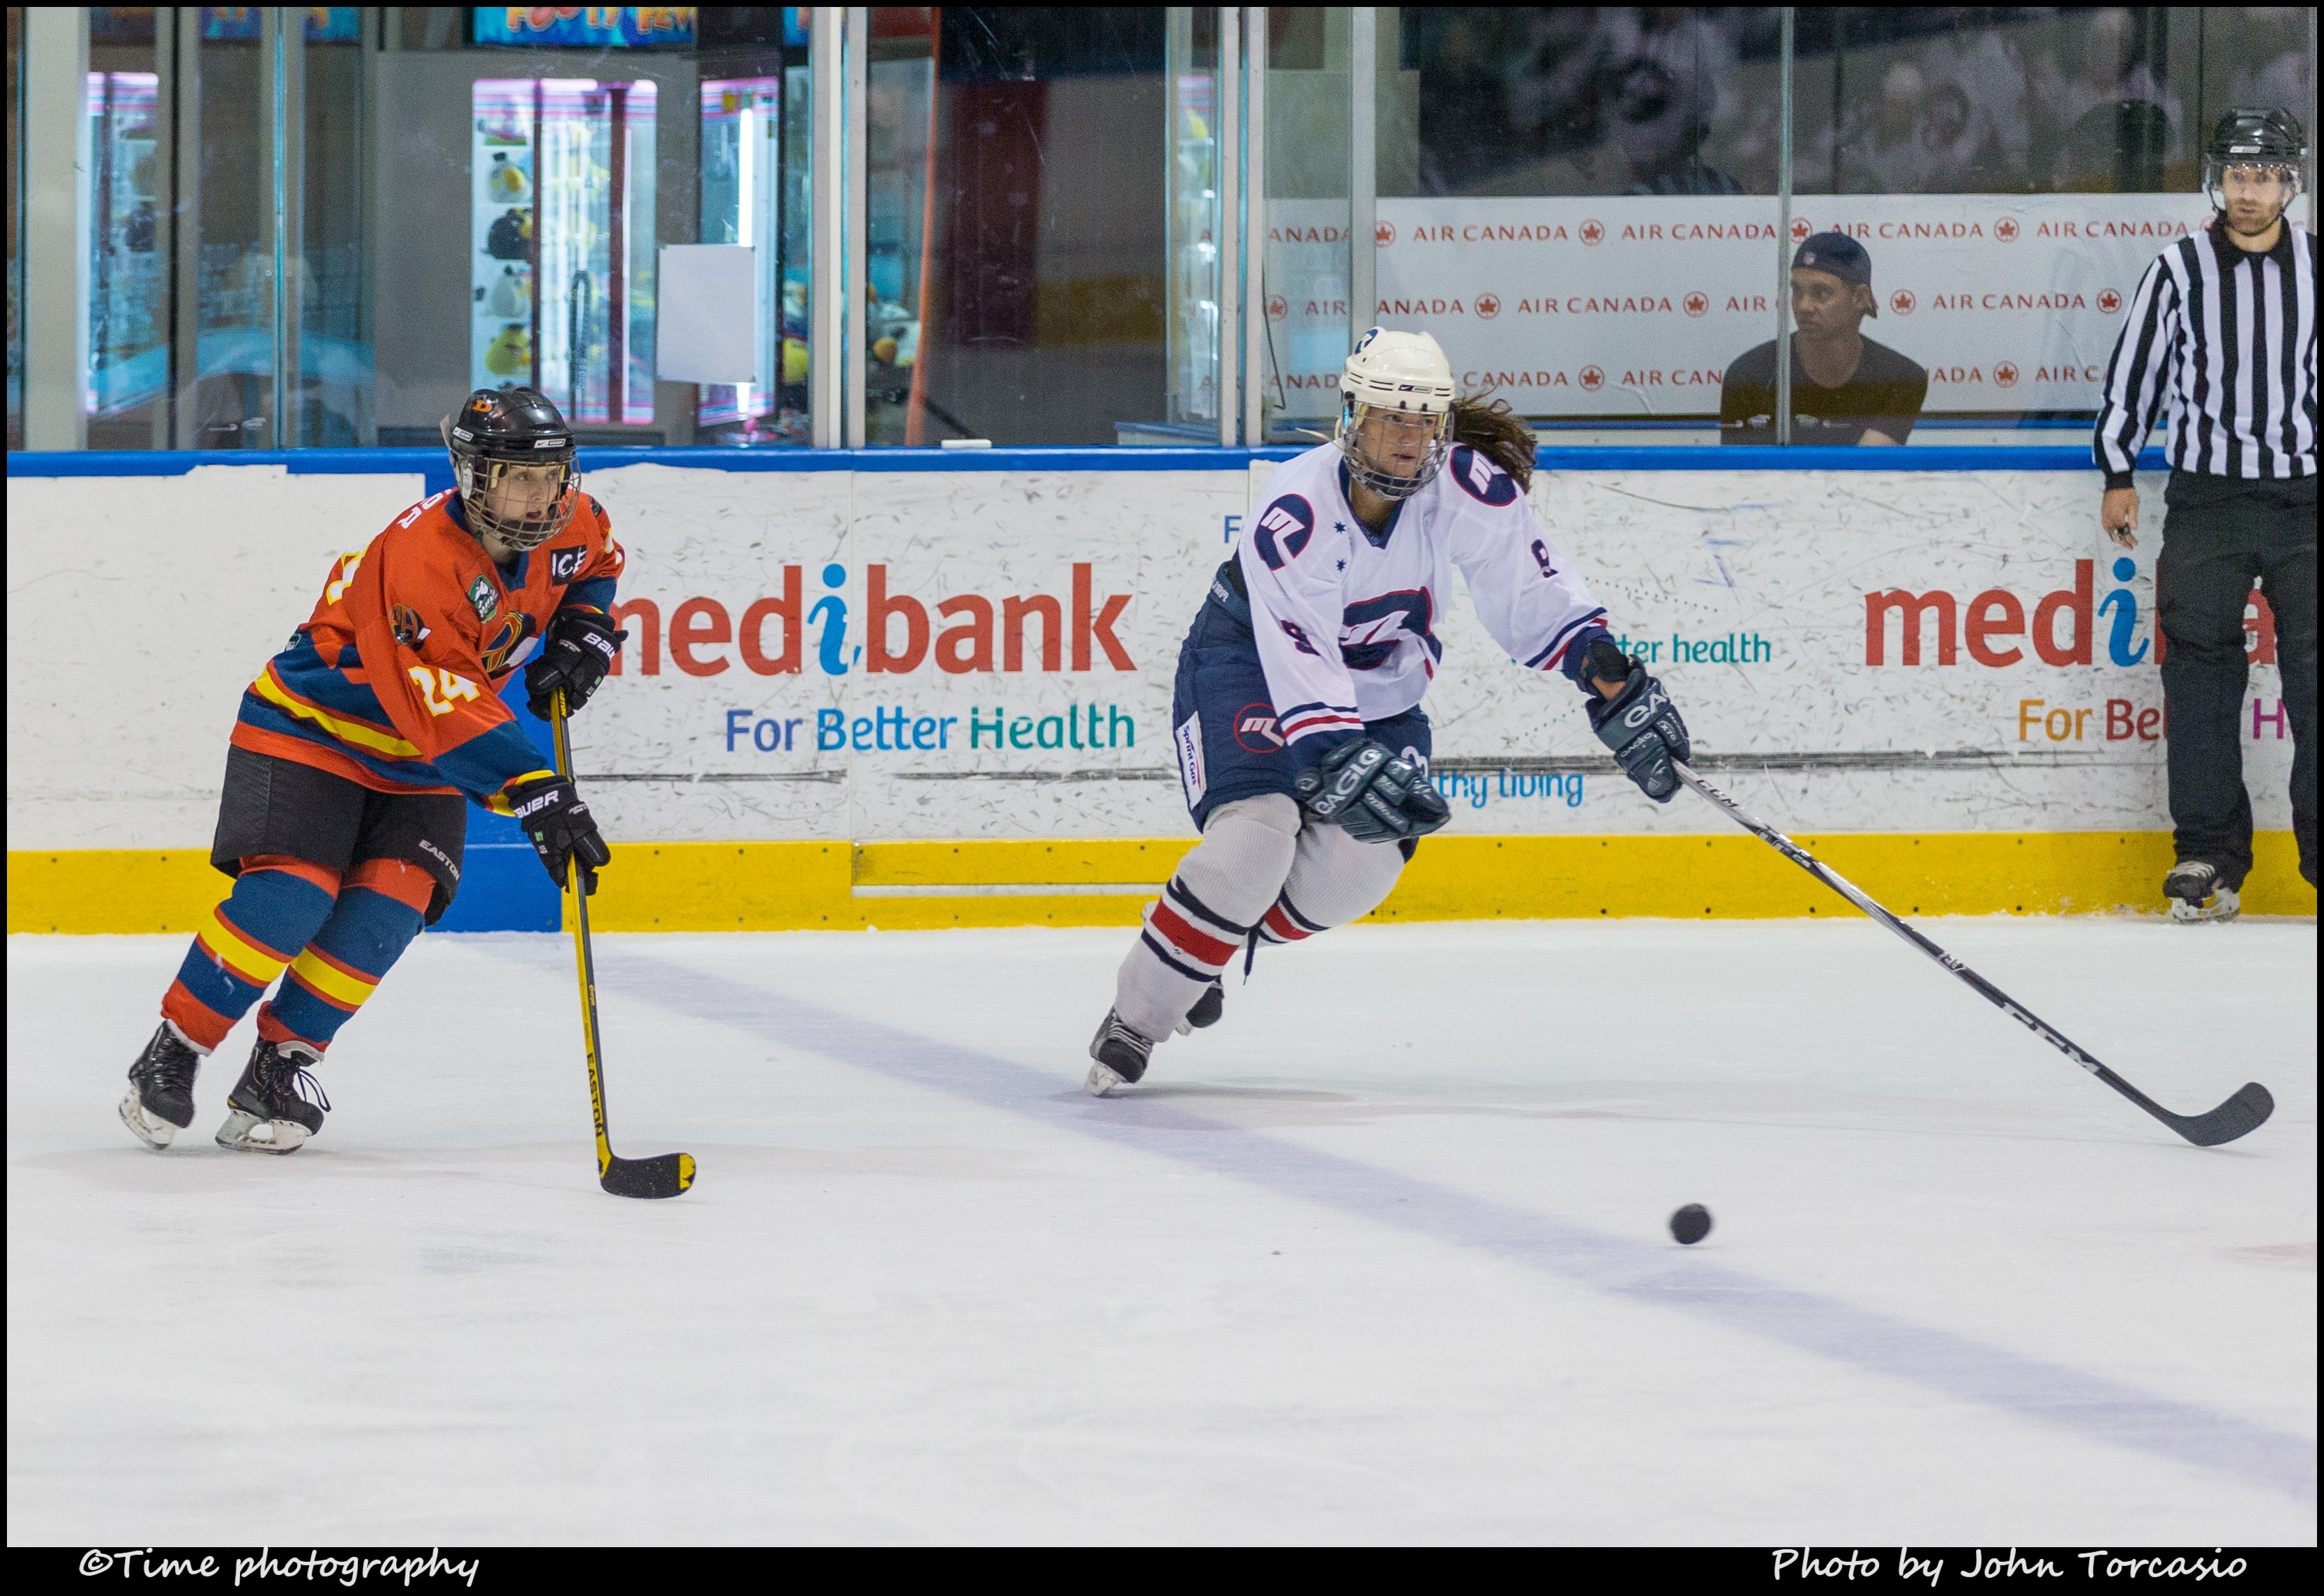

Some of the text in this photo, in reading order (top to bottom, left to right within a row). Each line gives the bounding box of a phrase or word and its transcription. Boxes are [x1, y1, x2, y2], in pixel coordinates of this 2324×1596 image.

[1414, 226, 1455, 242] AIR
[1463, 225, 1569, 242] CANADA
[1622, 224, 1663, 241] AIR
[1671, 223, 1776, 241] CANADA
[1832, 223, 1871, 238] AIR
[1879, 223, 1983, 239] CANADA
[2037, 221, 2077, 238] AIR
[2085, 220, 2189, 238] CANADA
[1376, 299, 1465, 315] ANADA
[1518, 297, 1558, 314] AIR
[1567, 296, 1673, 314] CANADA
[1726, 295, 1767, 312] AIR
[1933, 294, 1973, 310] AIR
[1982, 294, 2086, 310] CANADA
[1463, 370, 1569, 387] CANADA
[1622, 370, 1663, 386] AIR
[1671, 369, 1723, 386] CAN
[2035, 366, 2076, 383] AIR
[1673, 633, 1772, 664] health
[407, 665, 481, 718] 24
[727, 704, 1135, 753] For Better Health
[2019, 699, 2094, 742] For
[1182, 725, 1197, 786] Sprint Gas
[418, 838, 460, 881] EASTON
[587, 1052, 604, 1138] EASTON
